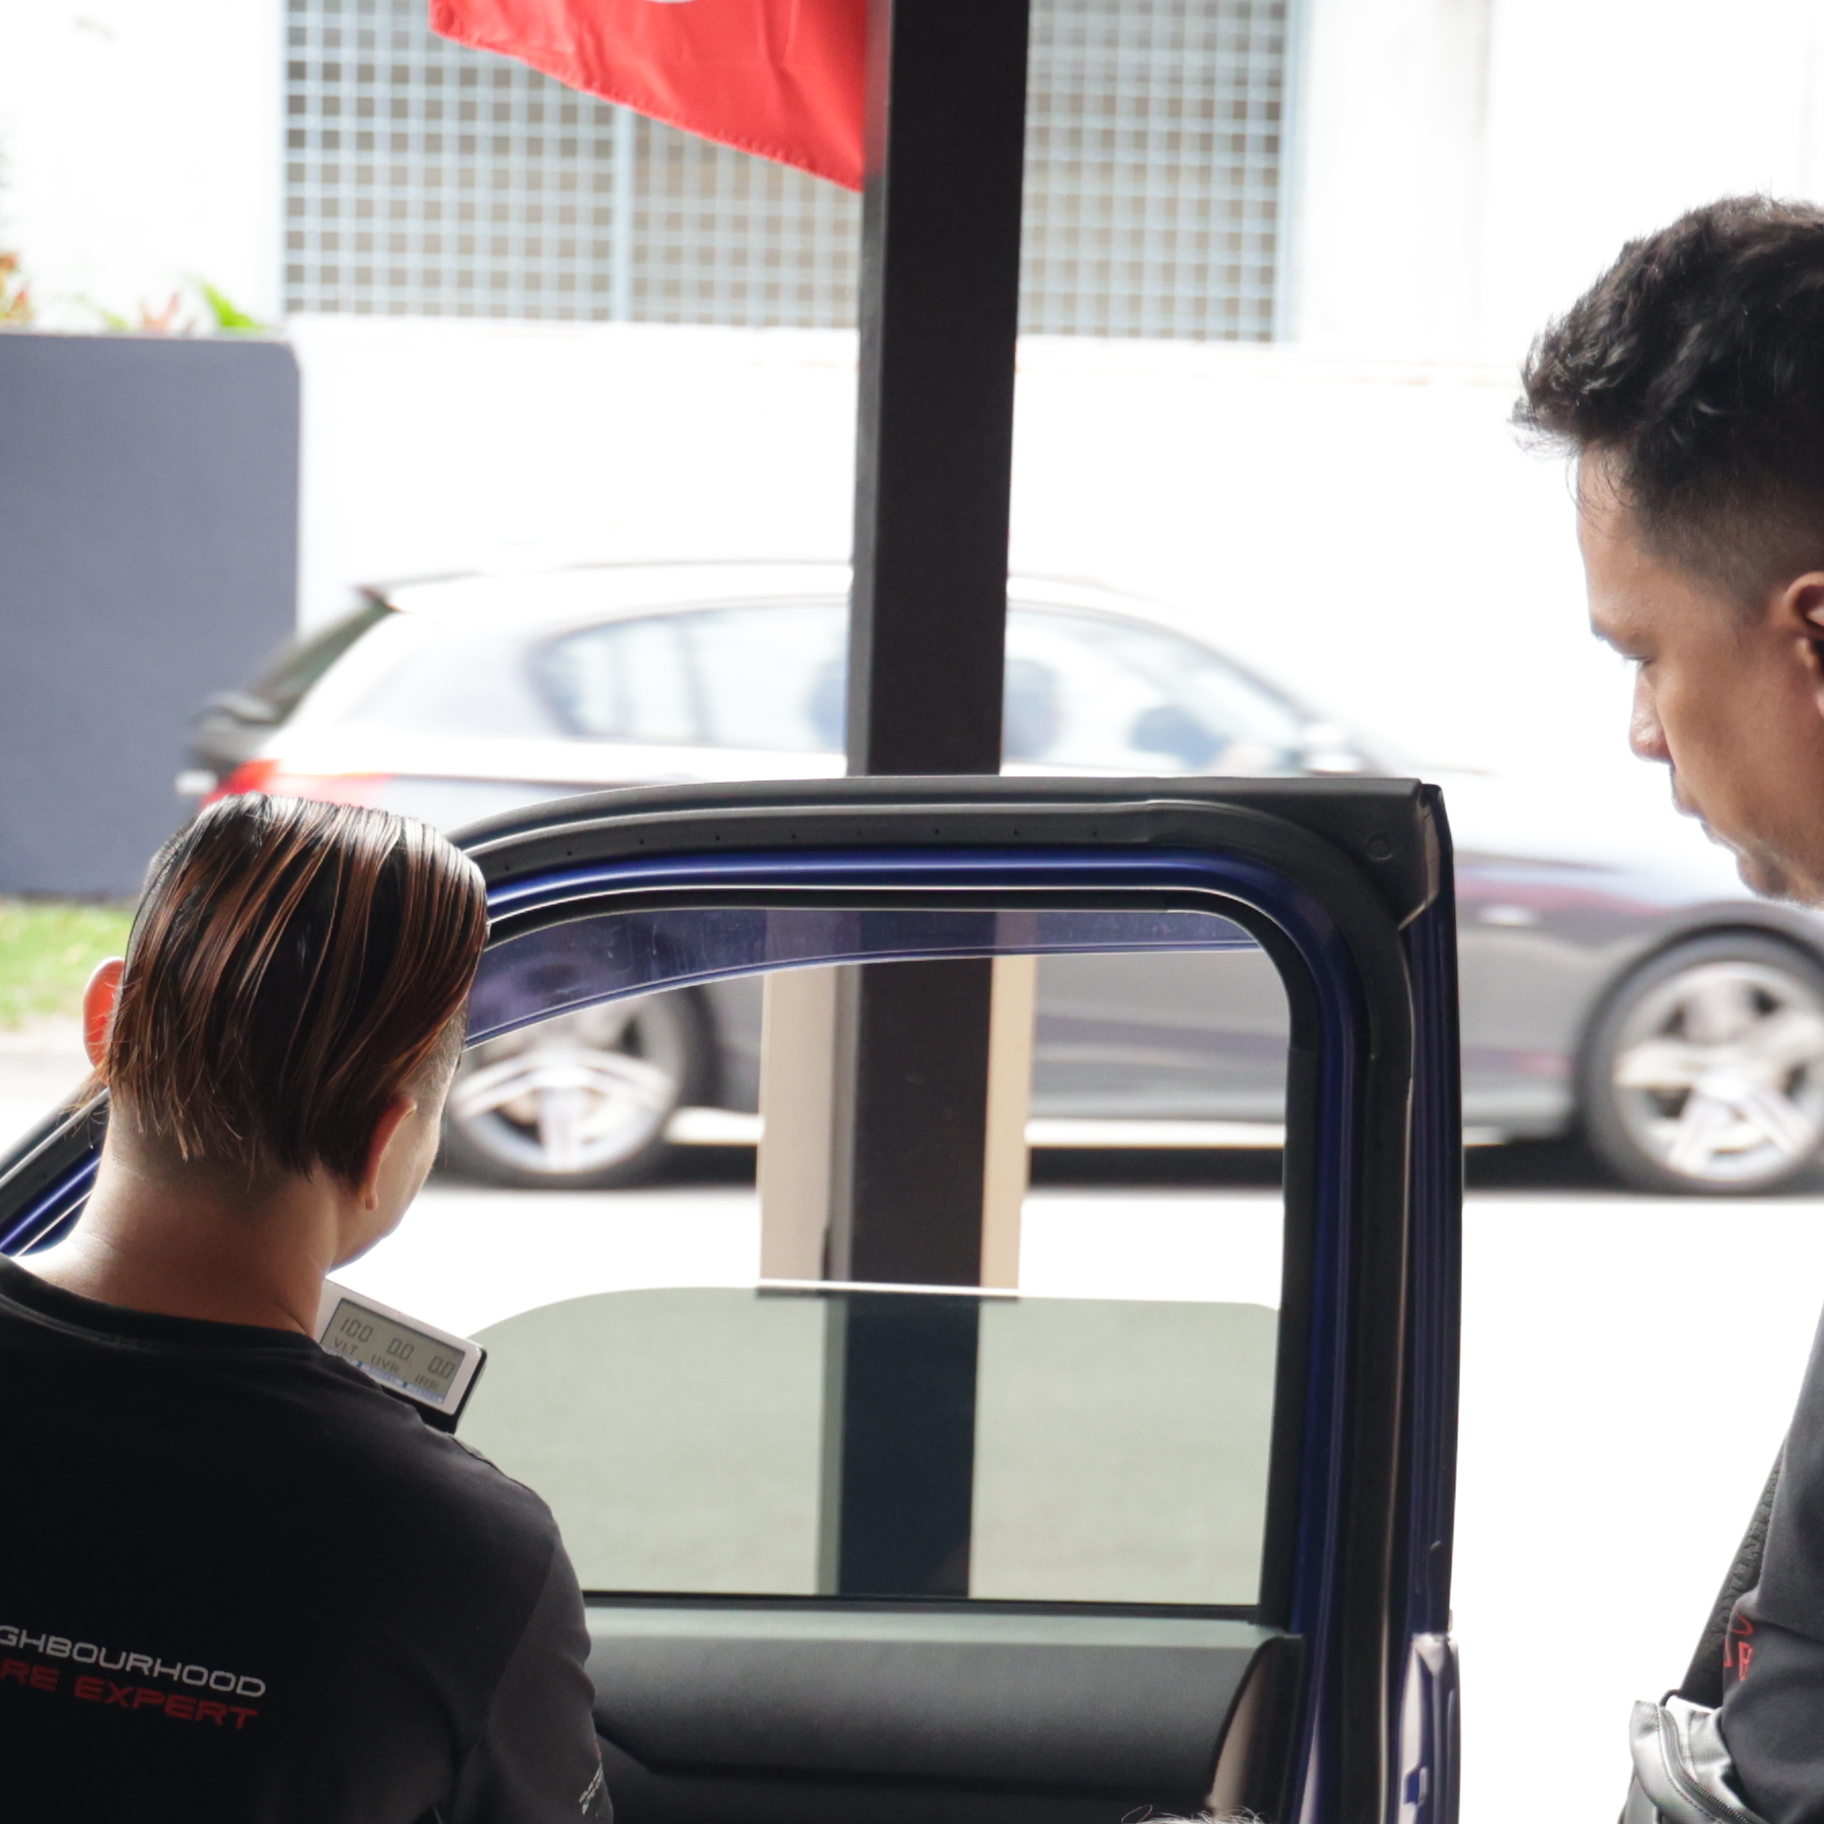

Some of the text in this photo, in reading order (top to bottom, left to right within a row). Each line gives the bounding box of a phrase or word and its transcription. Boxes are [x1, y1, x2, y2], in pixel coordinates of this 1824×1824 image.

[340, 1318, 374, 1343] 100
[334, 1338, 358, 1355] VLT
[371, 1354, 399, 1373] UVR
[74, 1674, 259, 1730] EXPERT
